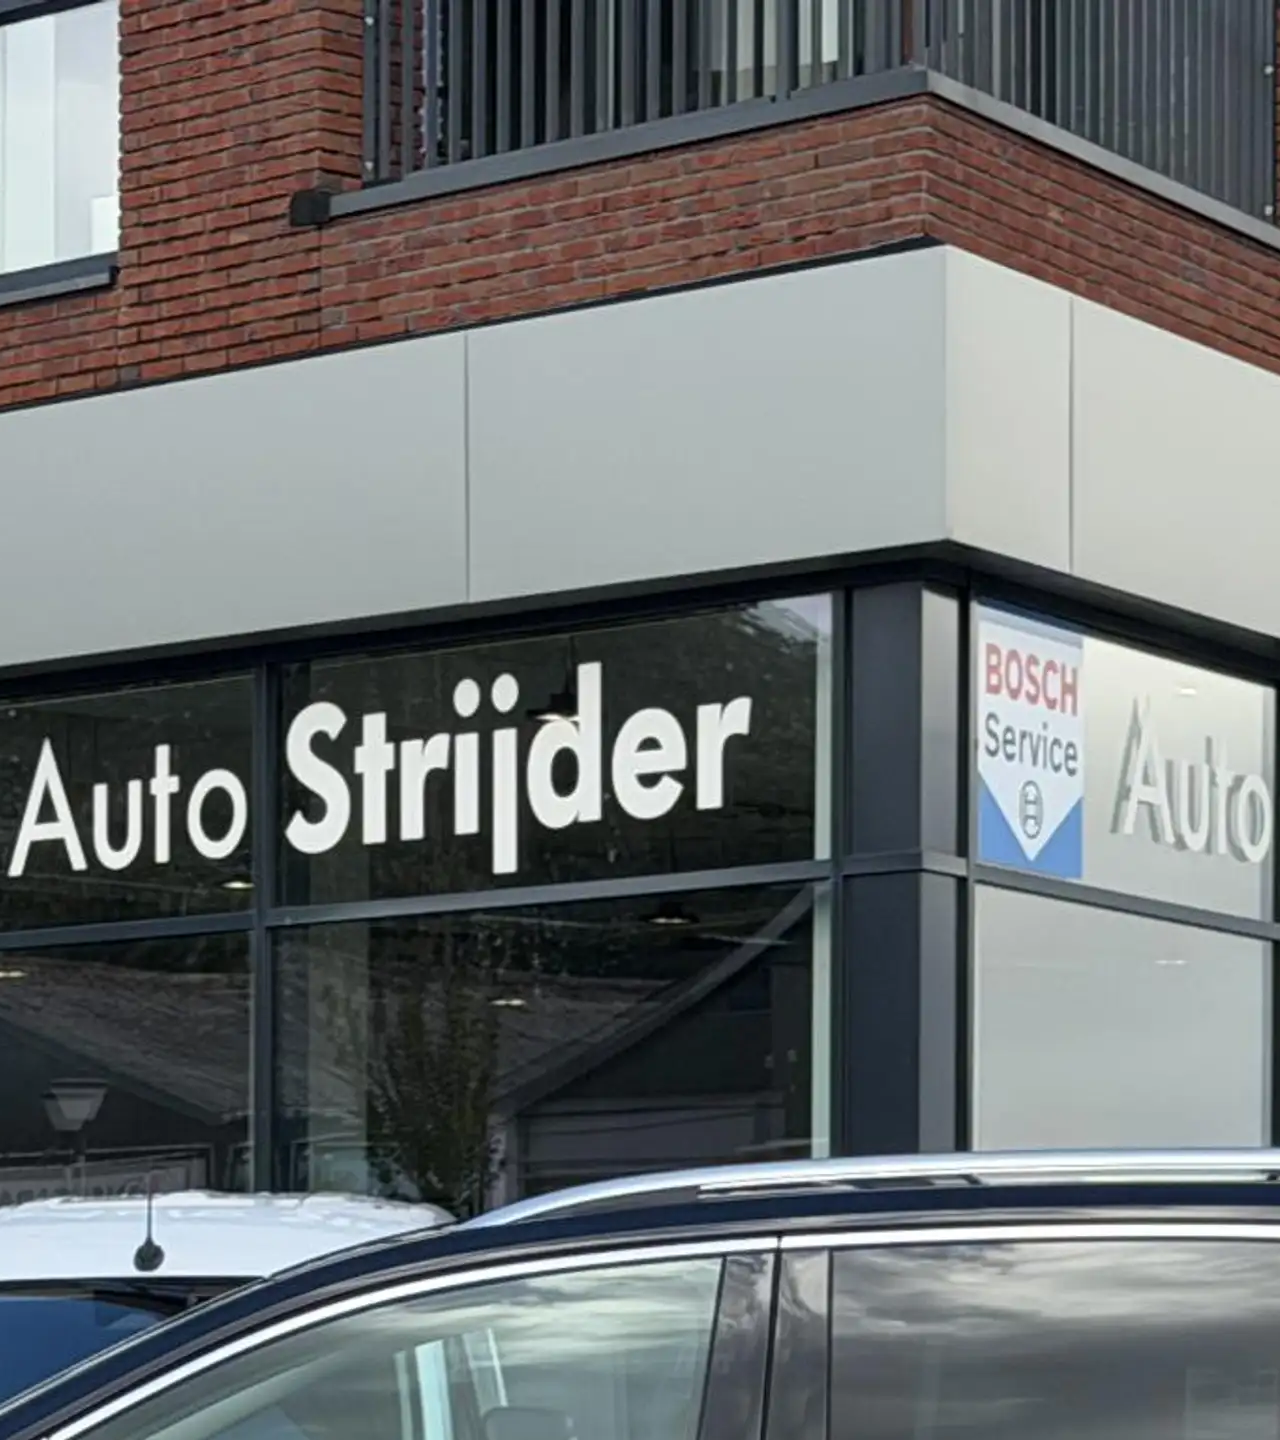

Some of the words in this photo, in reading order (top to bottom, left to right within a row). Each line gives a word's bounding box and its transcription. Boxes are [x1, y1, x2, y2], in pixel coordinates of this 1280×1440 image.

[985, 643, 1078, 716] BOSCH
[8, 738, 247, 877] Auto
[285, 661, 752, 875] Strijder
[985, 712, 1078, 777] Service
[1117, 692, 1272, 864] Auto
